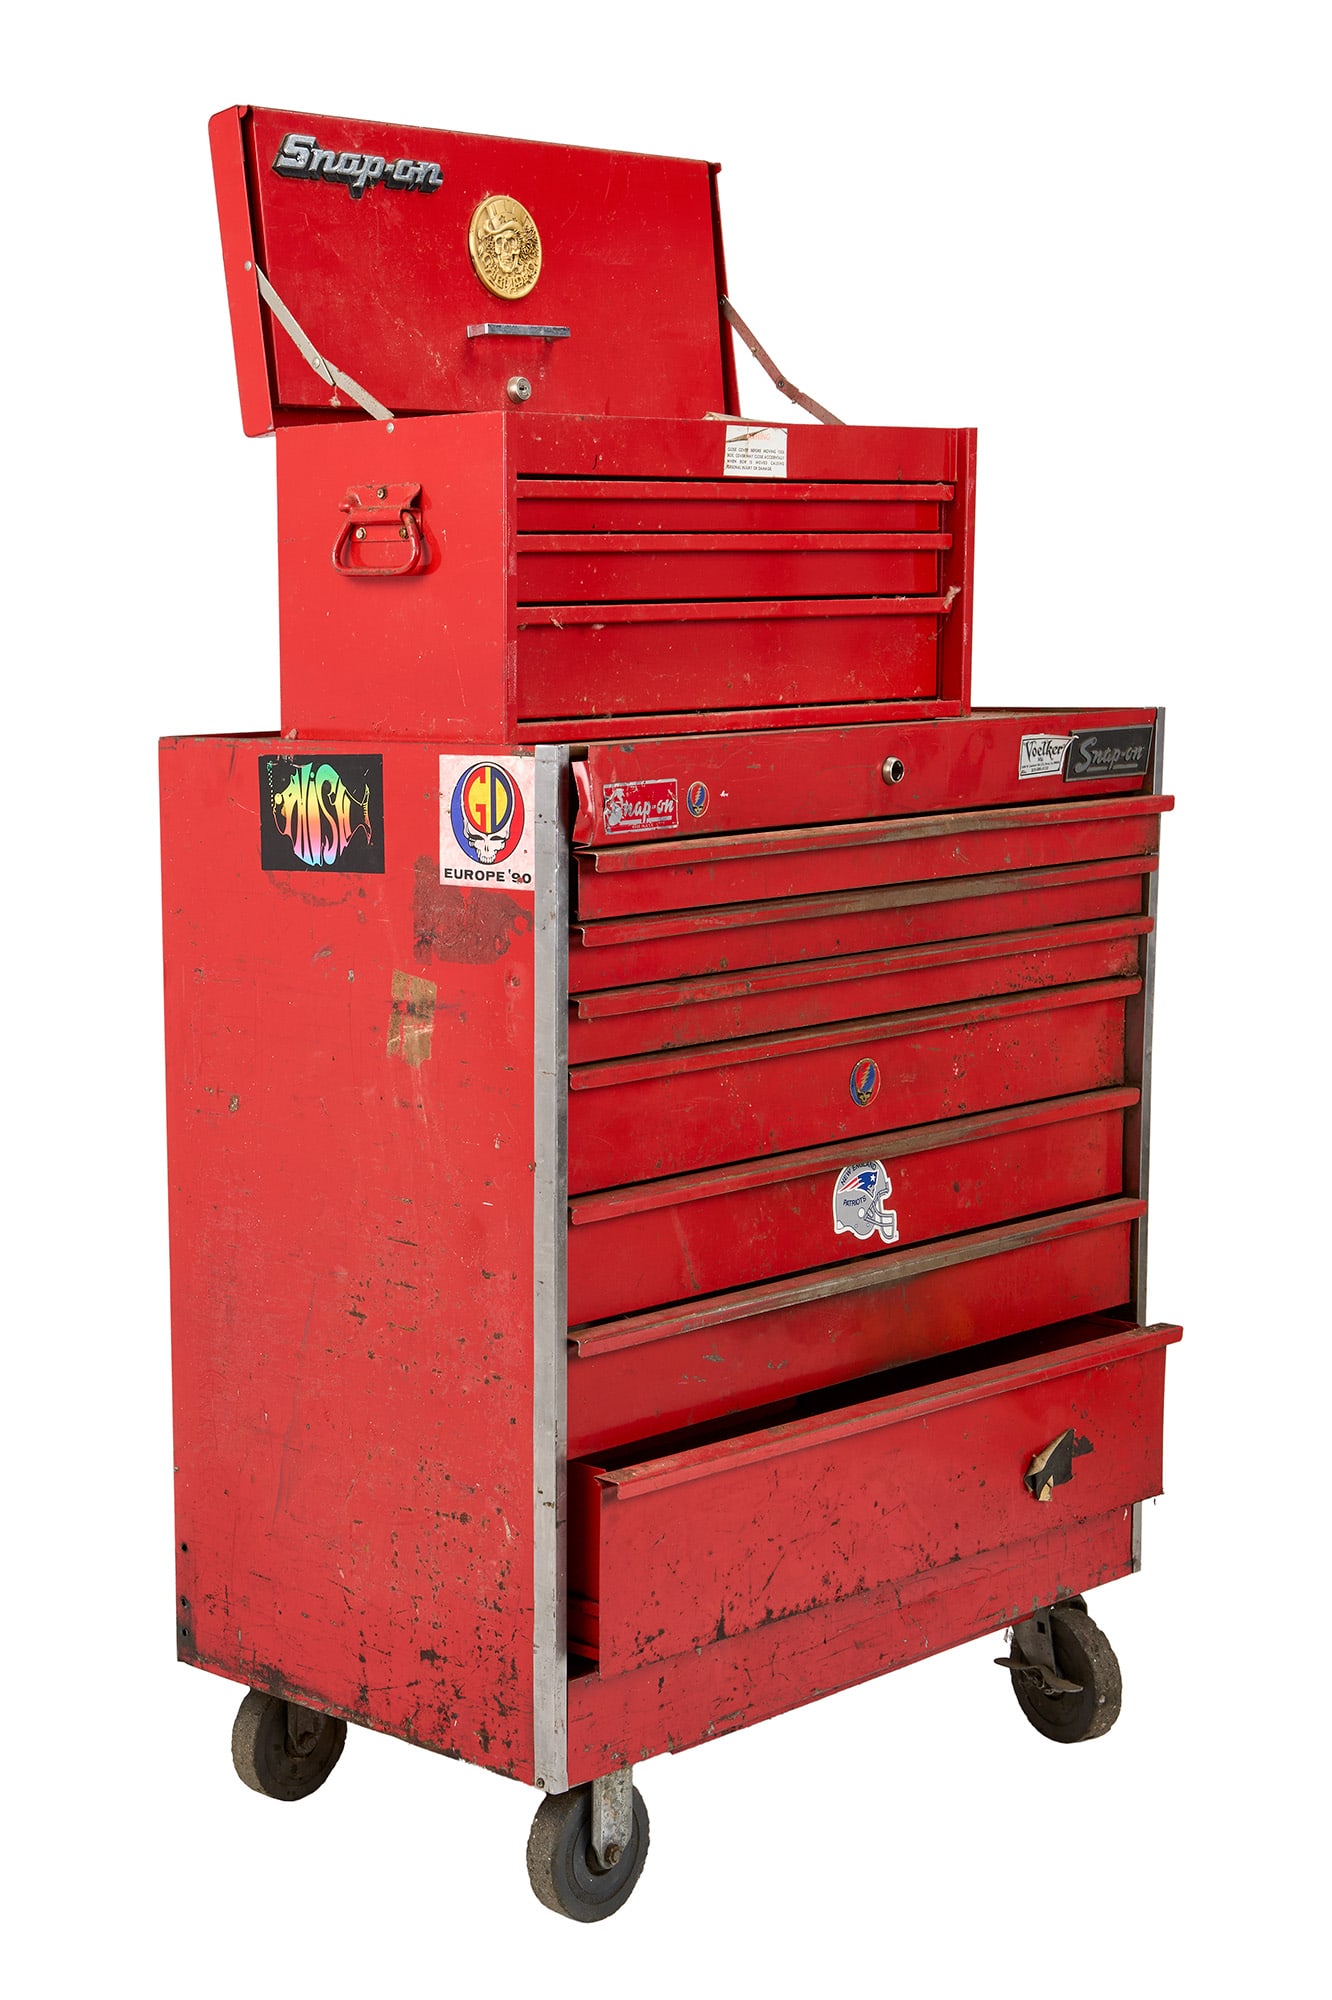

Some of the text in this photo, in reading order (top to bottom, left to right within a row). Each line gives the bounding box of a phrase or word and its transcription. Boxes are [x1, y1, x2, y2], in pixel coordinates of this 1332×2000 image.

[274, 133, 444, 190] Snap-on
[1023, 739, 1064, 762] Voelker
[1075, 736, 1144, 774] Snap-on
[444, 868, 532, 884] EUROPE '90
[841, 1169, 852, 1186] NEW
[843, 1195, 866, 1206] PATRIOTS
